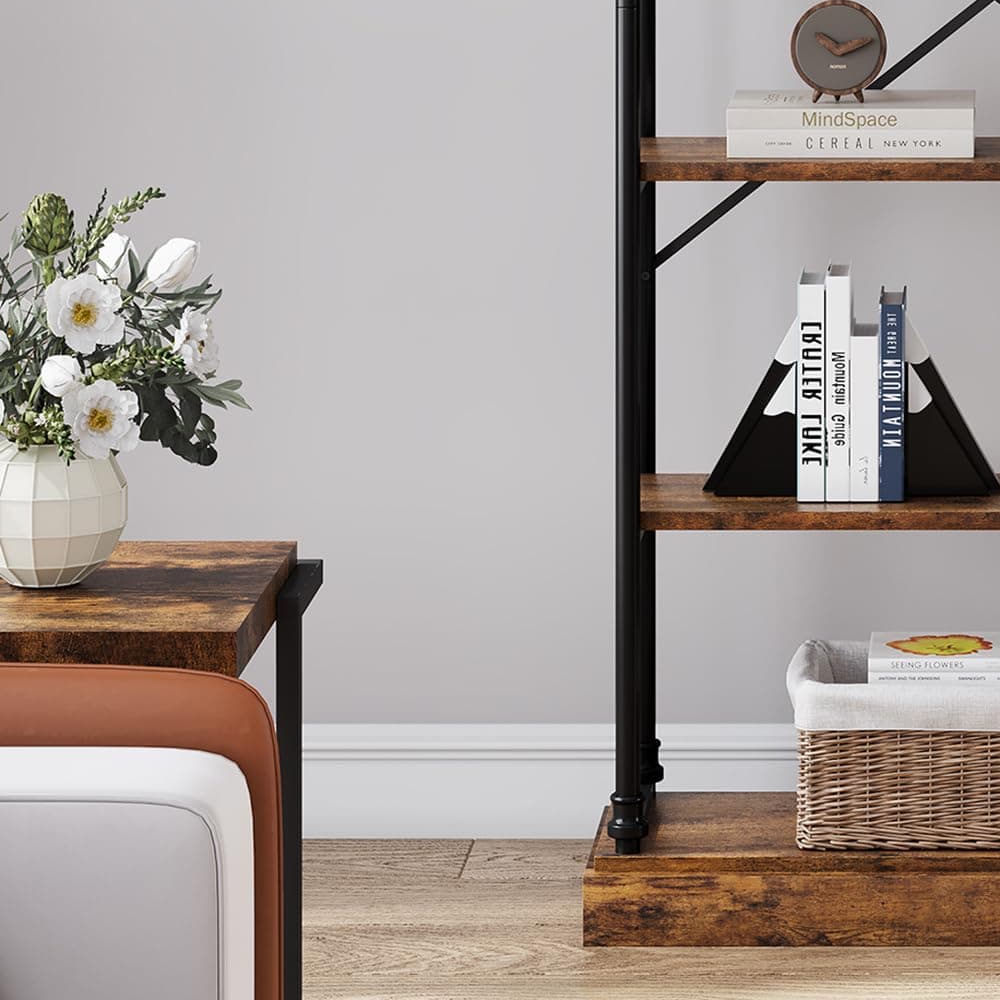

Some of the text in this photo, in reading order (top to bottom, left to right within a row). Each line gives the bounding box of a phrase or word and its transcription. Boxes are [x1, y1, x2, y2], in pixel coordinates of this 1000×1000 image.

[802, 111, 897, 130] MindSpace
[806, 136, 942, 150] CEREAL NEW YORK
[891, 661, 964, 670] SEEING FLOWERS
